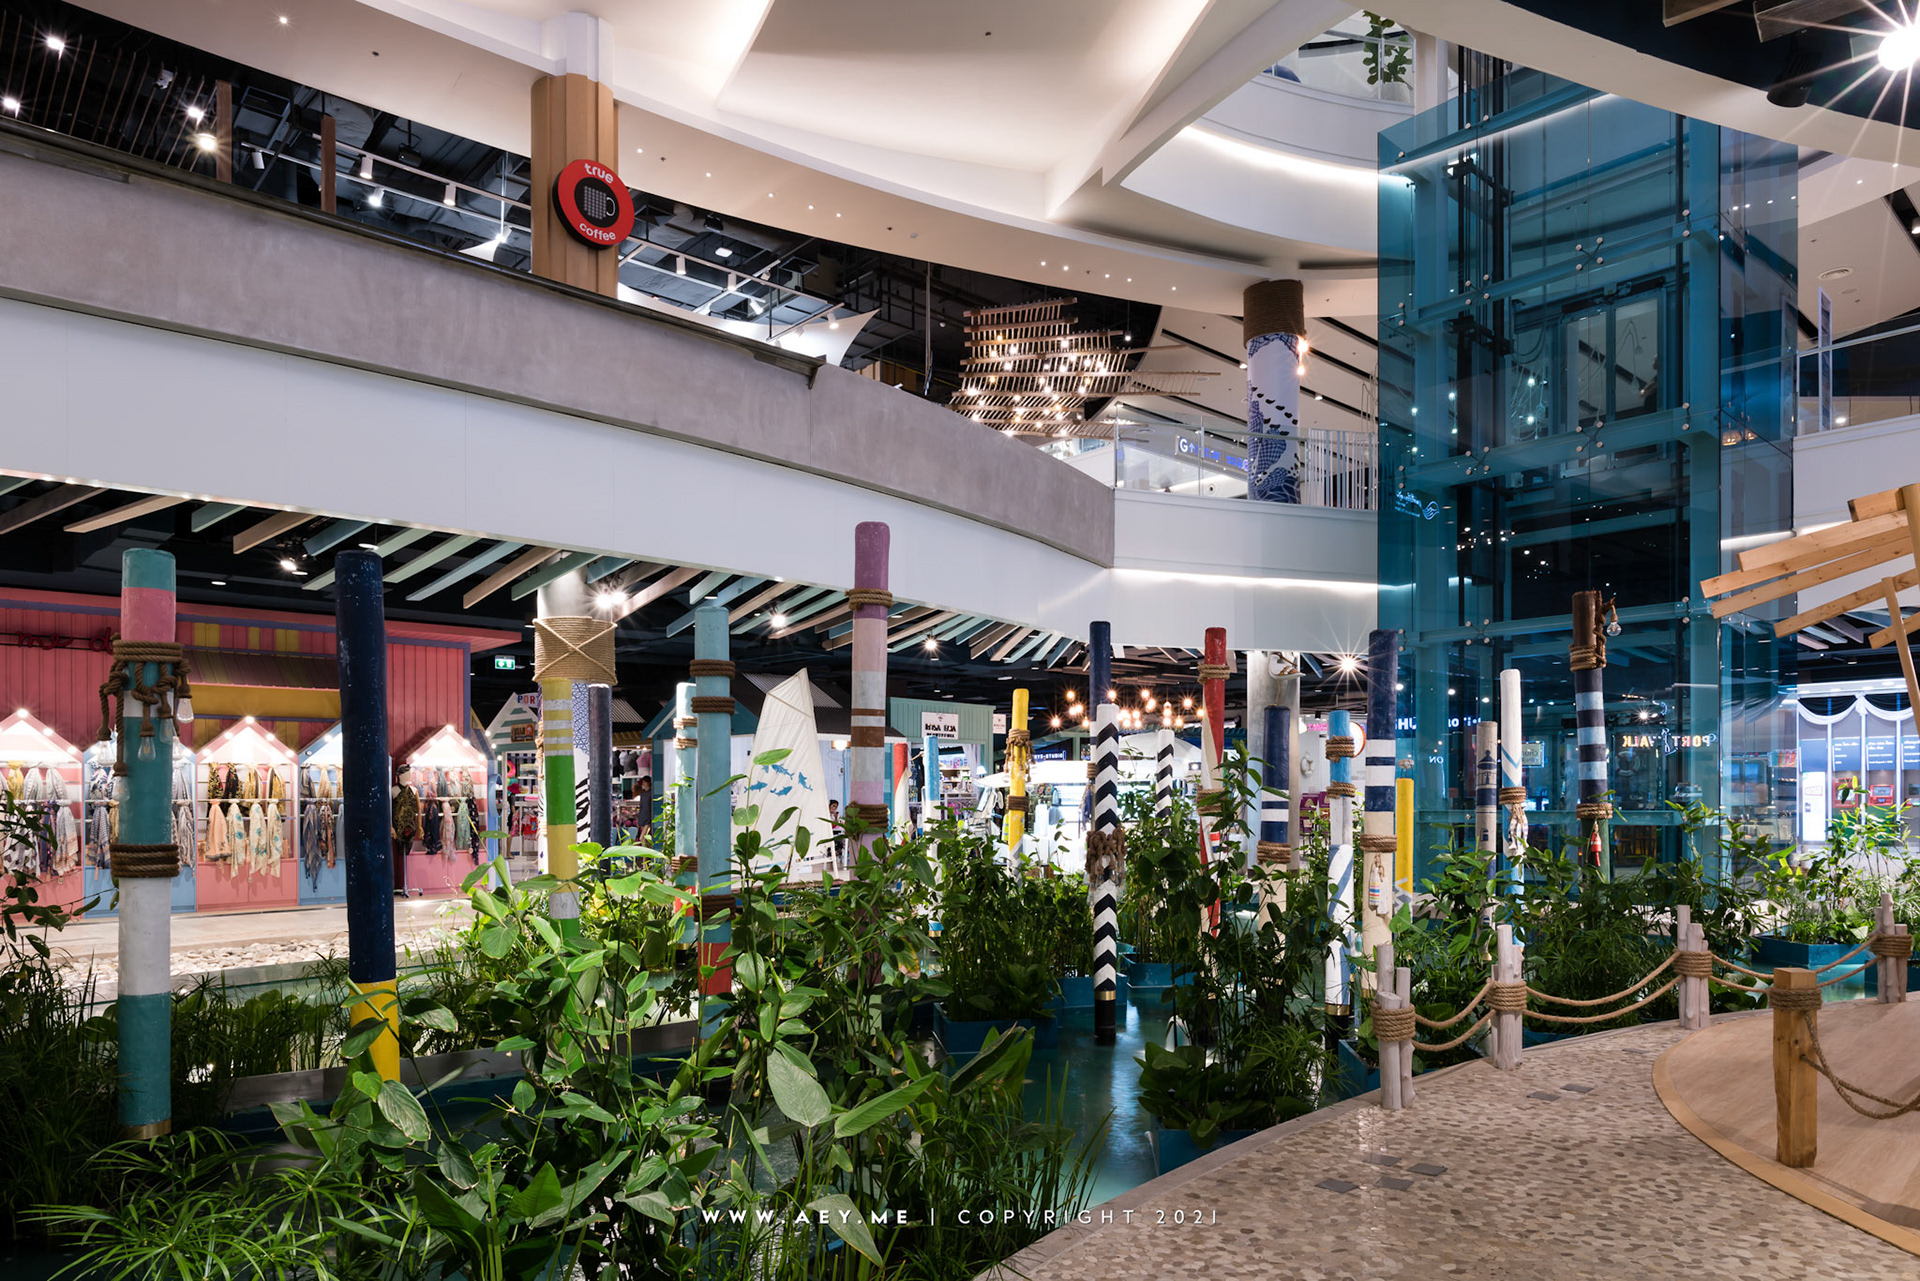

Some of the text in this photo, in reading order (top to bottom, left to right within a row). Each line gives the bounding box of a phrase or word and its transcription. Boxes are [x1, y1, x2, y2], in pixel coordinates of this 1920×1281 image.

[584, 163, 614, 184] true
[579, 223, 616, 241] coffee
[1179, 438, 1189, 453] G
